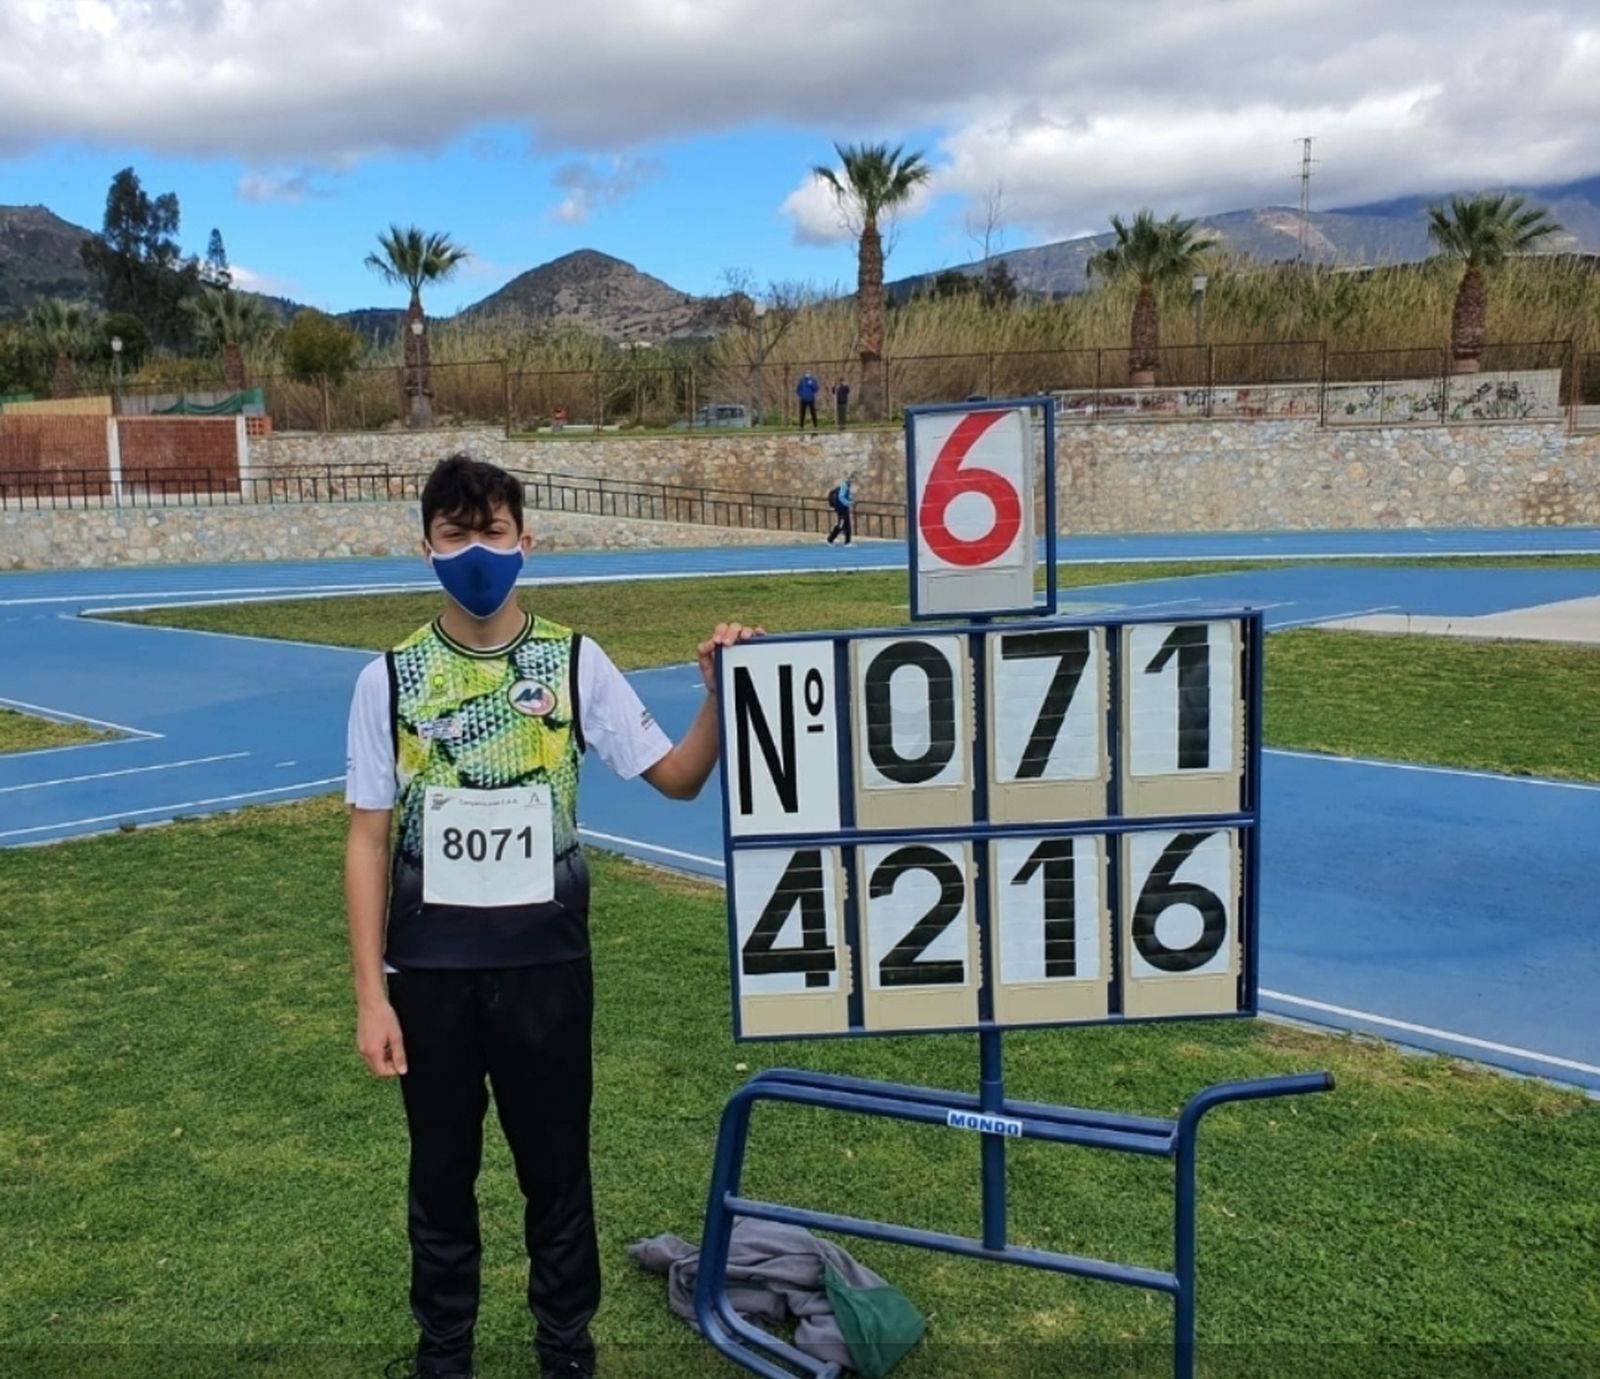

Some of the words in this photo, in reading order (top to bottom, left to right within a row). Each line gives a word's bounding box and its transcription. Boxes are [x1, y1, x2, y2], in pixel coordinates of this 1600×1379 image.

[919, 411, 1022, 567] 6
[733, 664, 825, 816] Nº
[442, 826, 532, 862] 8071
[950, 1113, 1019, 1135] MONDO
